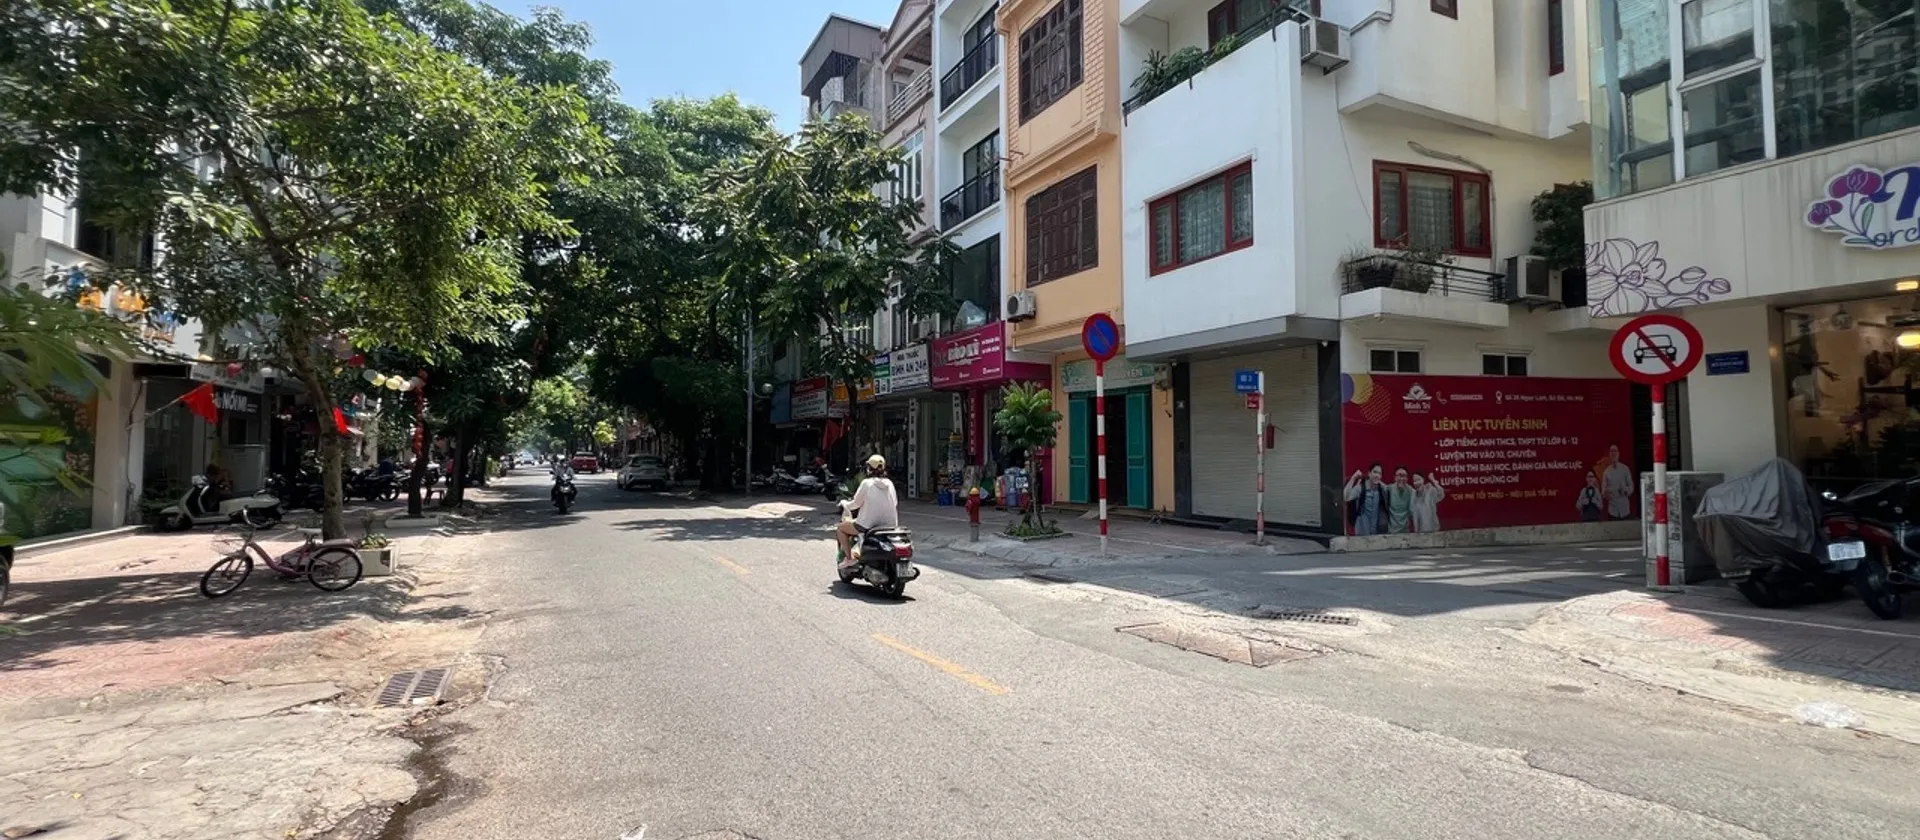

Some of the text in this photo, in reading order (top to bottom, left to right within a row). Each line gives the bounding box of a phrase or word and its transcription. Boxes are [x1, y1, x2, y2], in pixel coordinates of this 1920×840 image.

[1872, 216, 1920, 248] orc
[1432, 414, 1548, 434] LIÊN TỤC TUYỂN SINH
[1439, 437, 1455, 447] LỚP
[1455, 435, 1478, 447] TIẾNG
[1479, 437, 1495, 446] ANH
[1517, 437, 1535, 446] THPT
[1547, 436, 1561, 445] LỚP
[1440, 450, 1465, 461] LUYỆN
[1465, 451, 1478, 460] THI
[1479, 449, 1495, 459] VÀO
[1507, 448, 1537, 459] CHUYÊN
[1440, 463, 1465, 474] LUYỆN
[1466, 464, 1478, 472] THI
[1547, 460, 1568, 470] NĂNG
[1569, 460, 1583, 472] LỰC
[1440, 476, 1465, 487] LUYỆN
[1466, 476, 1478, 485] THI
[1479, 474, 1505, 485] CHỨNG
